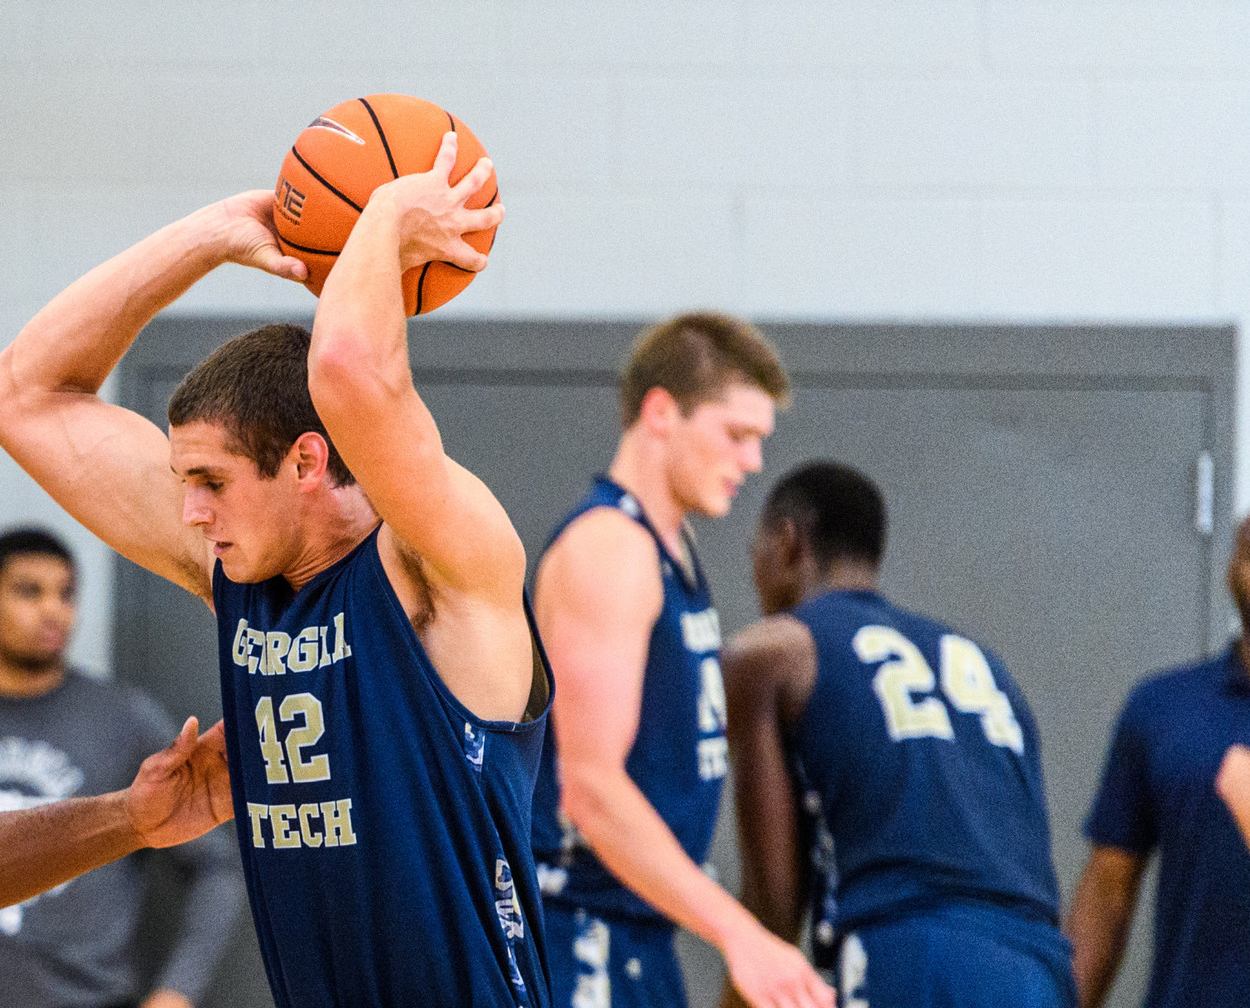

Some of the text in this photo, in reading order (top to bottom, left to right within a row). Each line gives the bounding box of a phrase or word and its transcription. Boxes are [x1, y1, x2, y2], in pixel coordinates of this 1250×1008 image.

[852, 625, 1024, 757] 24
[255, 692, 331, 784] 42
[246, 798, 357, 849] TECH
